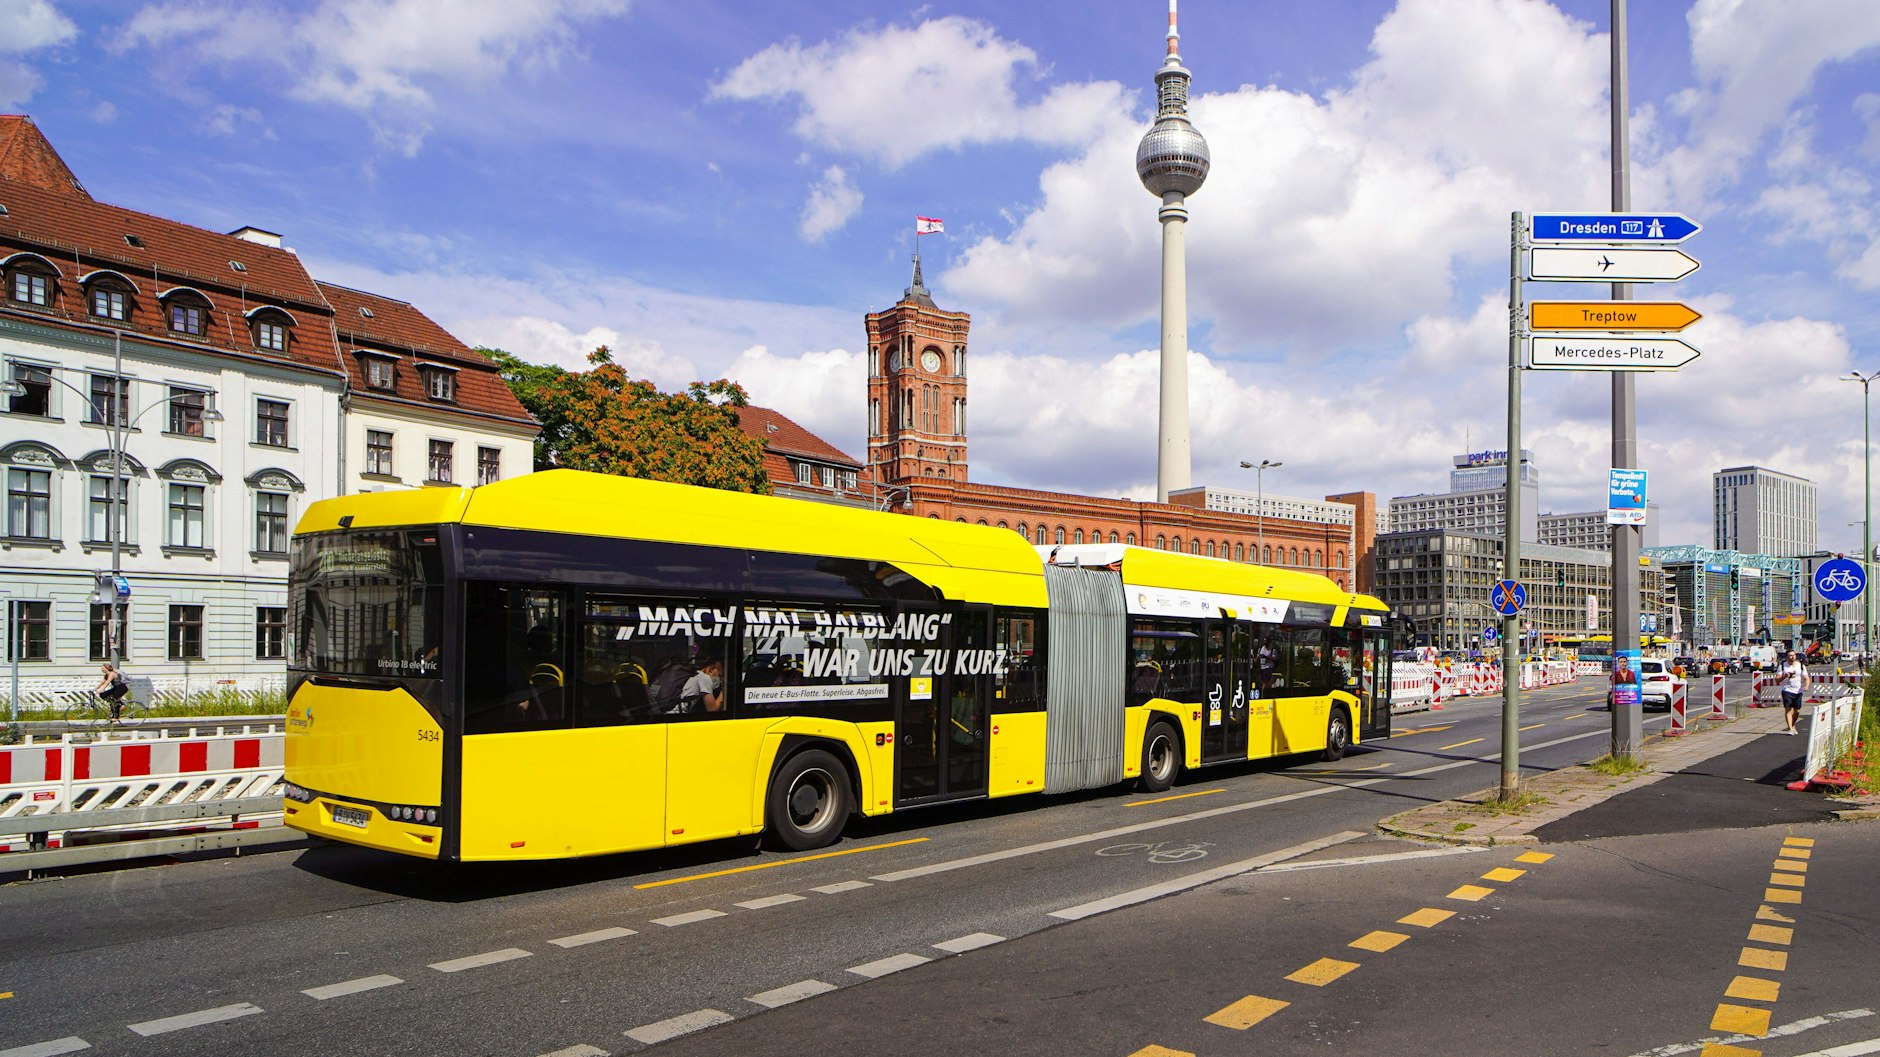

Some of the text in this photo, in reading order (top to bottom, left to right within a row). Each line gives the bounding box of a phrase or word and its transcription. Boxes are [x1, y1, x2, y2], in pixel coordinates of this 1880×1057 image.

[1560, 221, 1638, 234] Dresden 117
[1581, 310, 1637, 324] Treptow
[1555, 346, 1664, 359] Mercedes-Platz
[1469, 450, 1491, 465] park
[1611, 471, 1644, 481] Tempolimit
[1611, 479, 1638, 489] für grüne
[744, 610, 807, 638] MAL
[377, 659, 400, 668] Urbino
[401, 660, 408, 669] 18
[803, 648, 1009, 677] WAR UNS ZU KURZ.
[748, 686, 886, 700] Die neue E-Bus-Flotte. Superleise. Abgasfrei.
[417, 729, 440, 743] 5434
